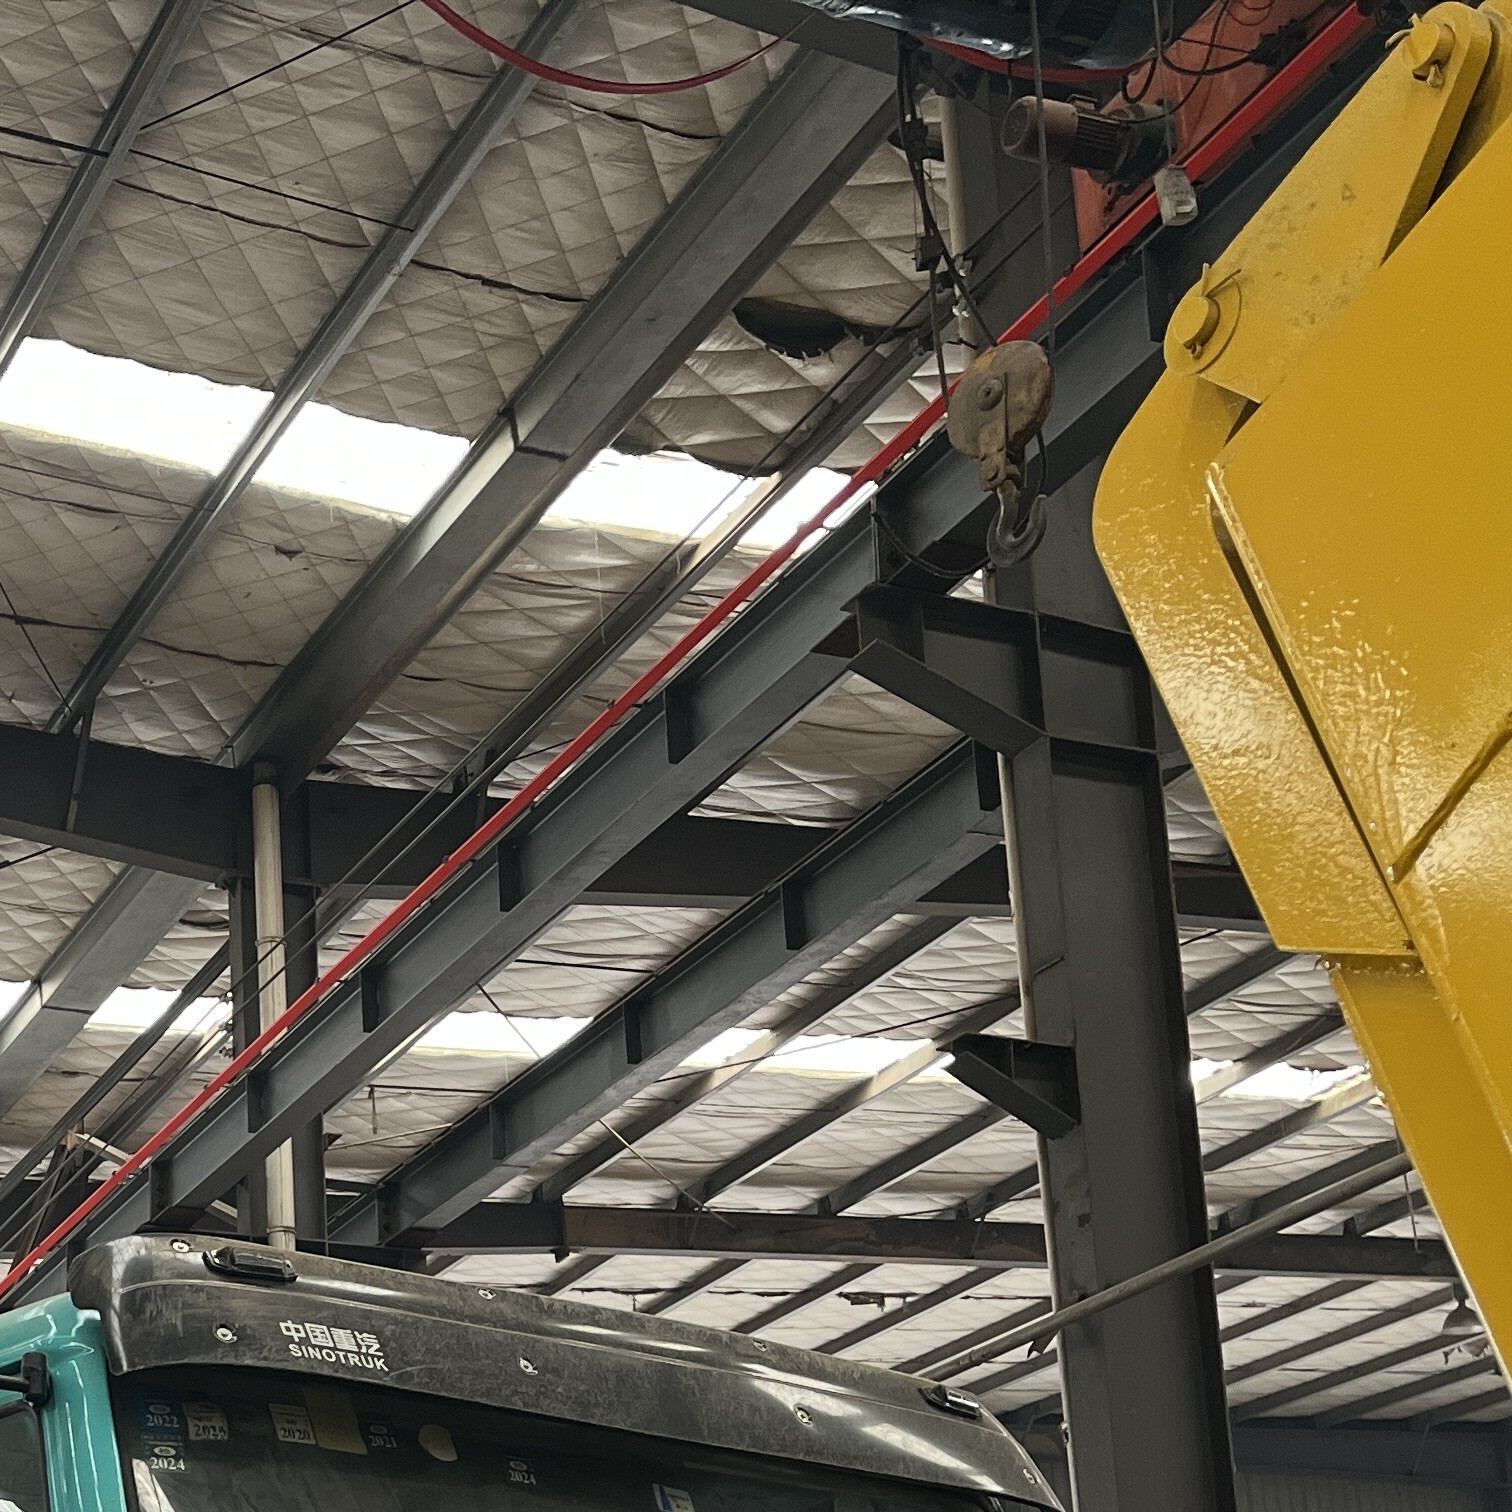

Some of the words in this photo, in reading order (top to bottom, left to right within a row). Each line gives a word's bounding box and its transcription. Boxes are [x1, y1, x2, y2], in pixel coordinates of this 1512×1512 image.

[278, 1320, 383, 1356] 中国重汽
[288, 1344, 389, 1372] SINOTRUK
[145, 1414, 180, 1428] 2022
[149, 1456, 186, 1471] 2024
[508, 1470, 537, 1485] 2024
